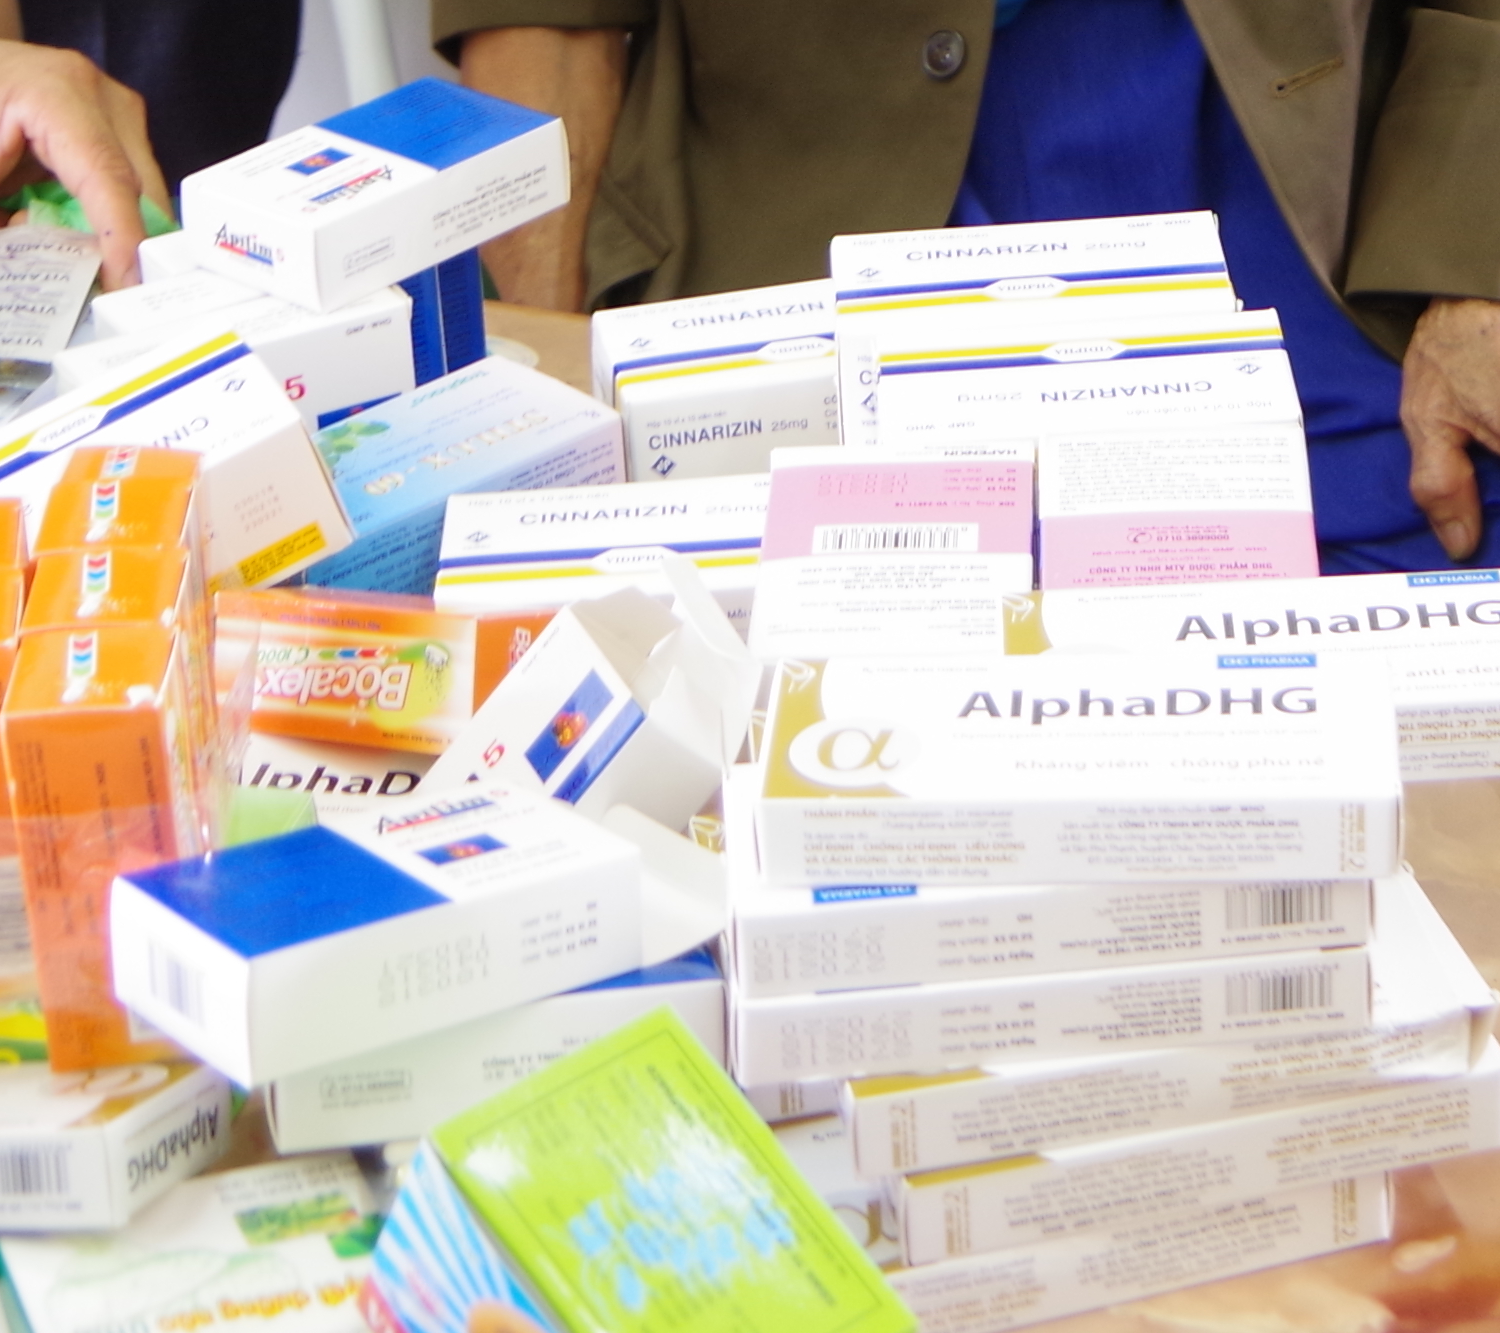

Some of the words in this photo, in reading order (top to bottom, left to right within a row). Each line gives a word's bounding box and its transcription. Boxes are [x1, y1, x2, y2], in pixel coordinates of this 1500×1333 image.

[906, 242, 1068, 262] CINNARIZIN
[1085, 239, 1146, 251] 25mg
[997, 281, 1055, 293] VIDIPHA
[671, 300, 825, 329] CINNARIZIN
[769, 341, 824, 354] VIDIPHA
[1054, 344, 1114, 356] VIDIPHA
[285, 375, 306, 402] 5
[957, 390, 1023, 404] 25mg
[1040, 380, 1213, 404] CINNARIZIN
[648, 418, 763, 451] CINNARIZIN
[771, 418, 809, 433] 25mg
[519, 504, 689, 526] CINNARIZIN
[705, 504, 768, 516] 25mg
[605, 553, 666, 565] VIDIPHA
[1089, 565, 1117, 575] CÔNG
[1121, 565, 1131, 573] TY
[1135, 564, 1161, 573] TNHH
[1165, 563, 1186, 572] MTV
[1189, 562, 1216, 572] DƯỢC
[1220, 560, 1248, 571] PHẨM
[1252, 561, 1273, 570] DHG
[1441, 570, 1495, 585] PHARMA
[1251, 654, 1311, 668] PHARMA
[260, 662, 415, 711] Bocalex
[957, 686, 1318, 726] AlphaDHG
[483, 738, 507, 769] 5
[1014, 756, 1087, 773] Kháng
[1095, 755, 1151, 770] viêm
[1169, 755, 1241, 773] chống
[1248, 754, 1292, 773] phù
[238, 763, 421, 796] lphaD
[126, 1102, 221, 1193] AlphaDHG
